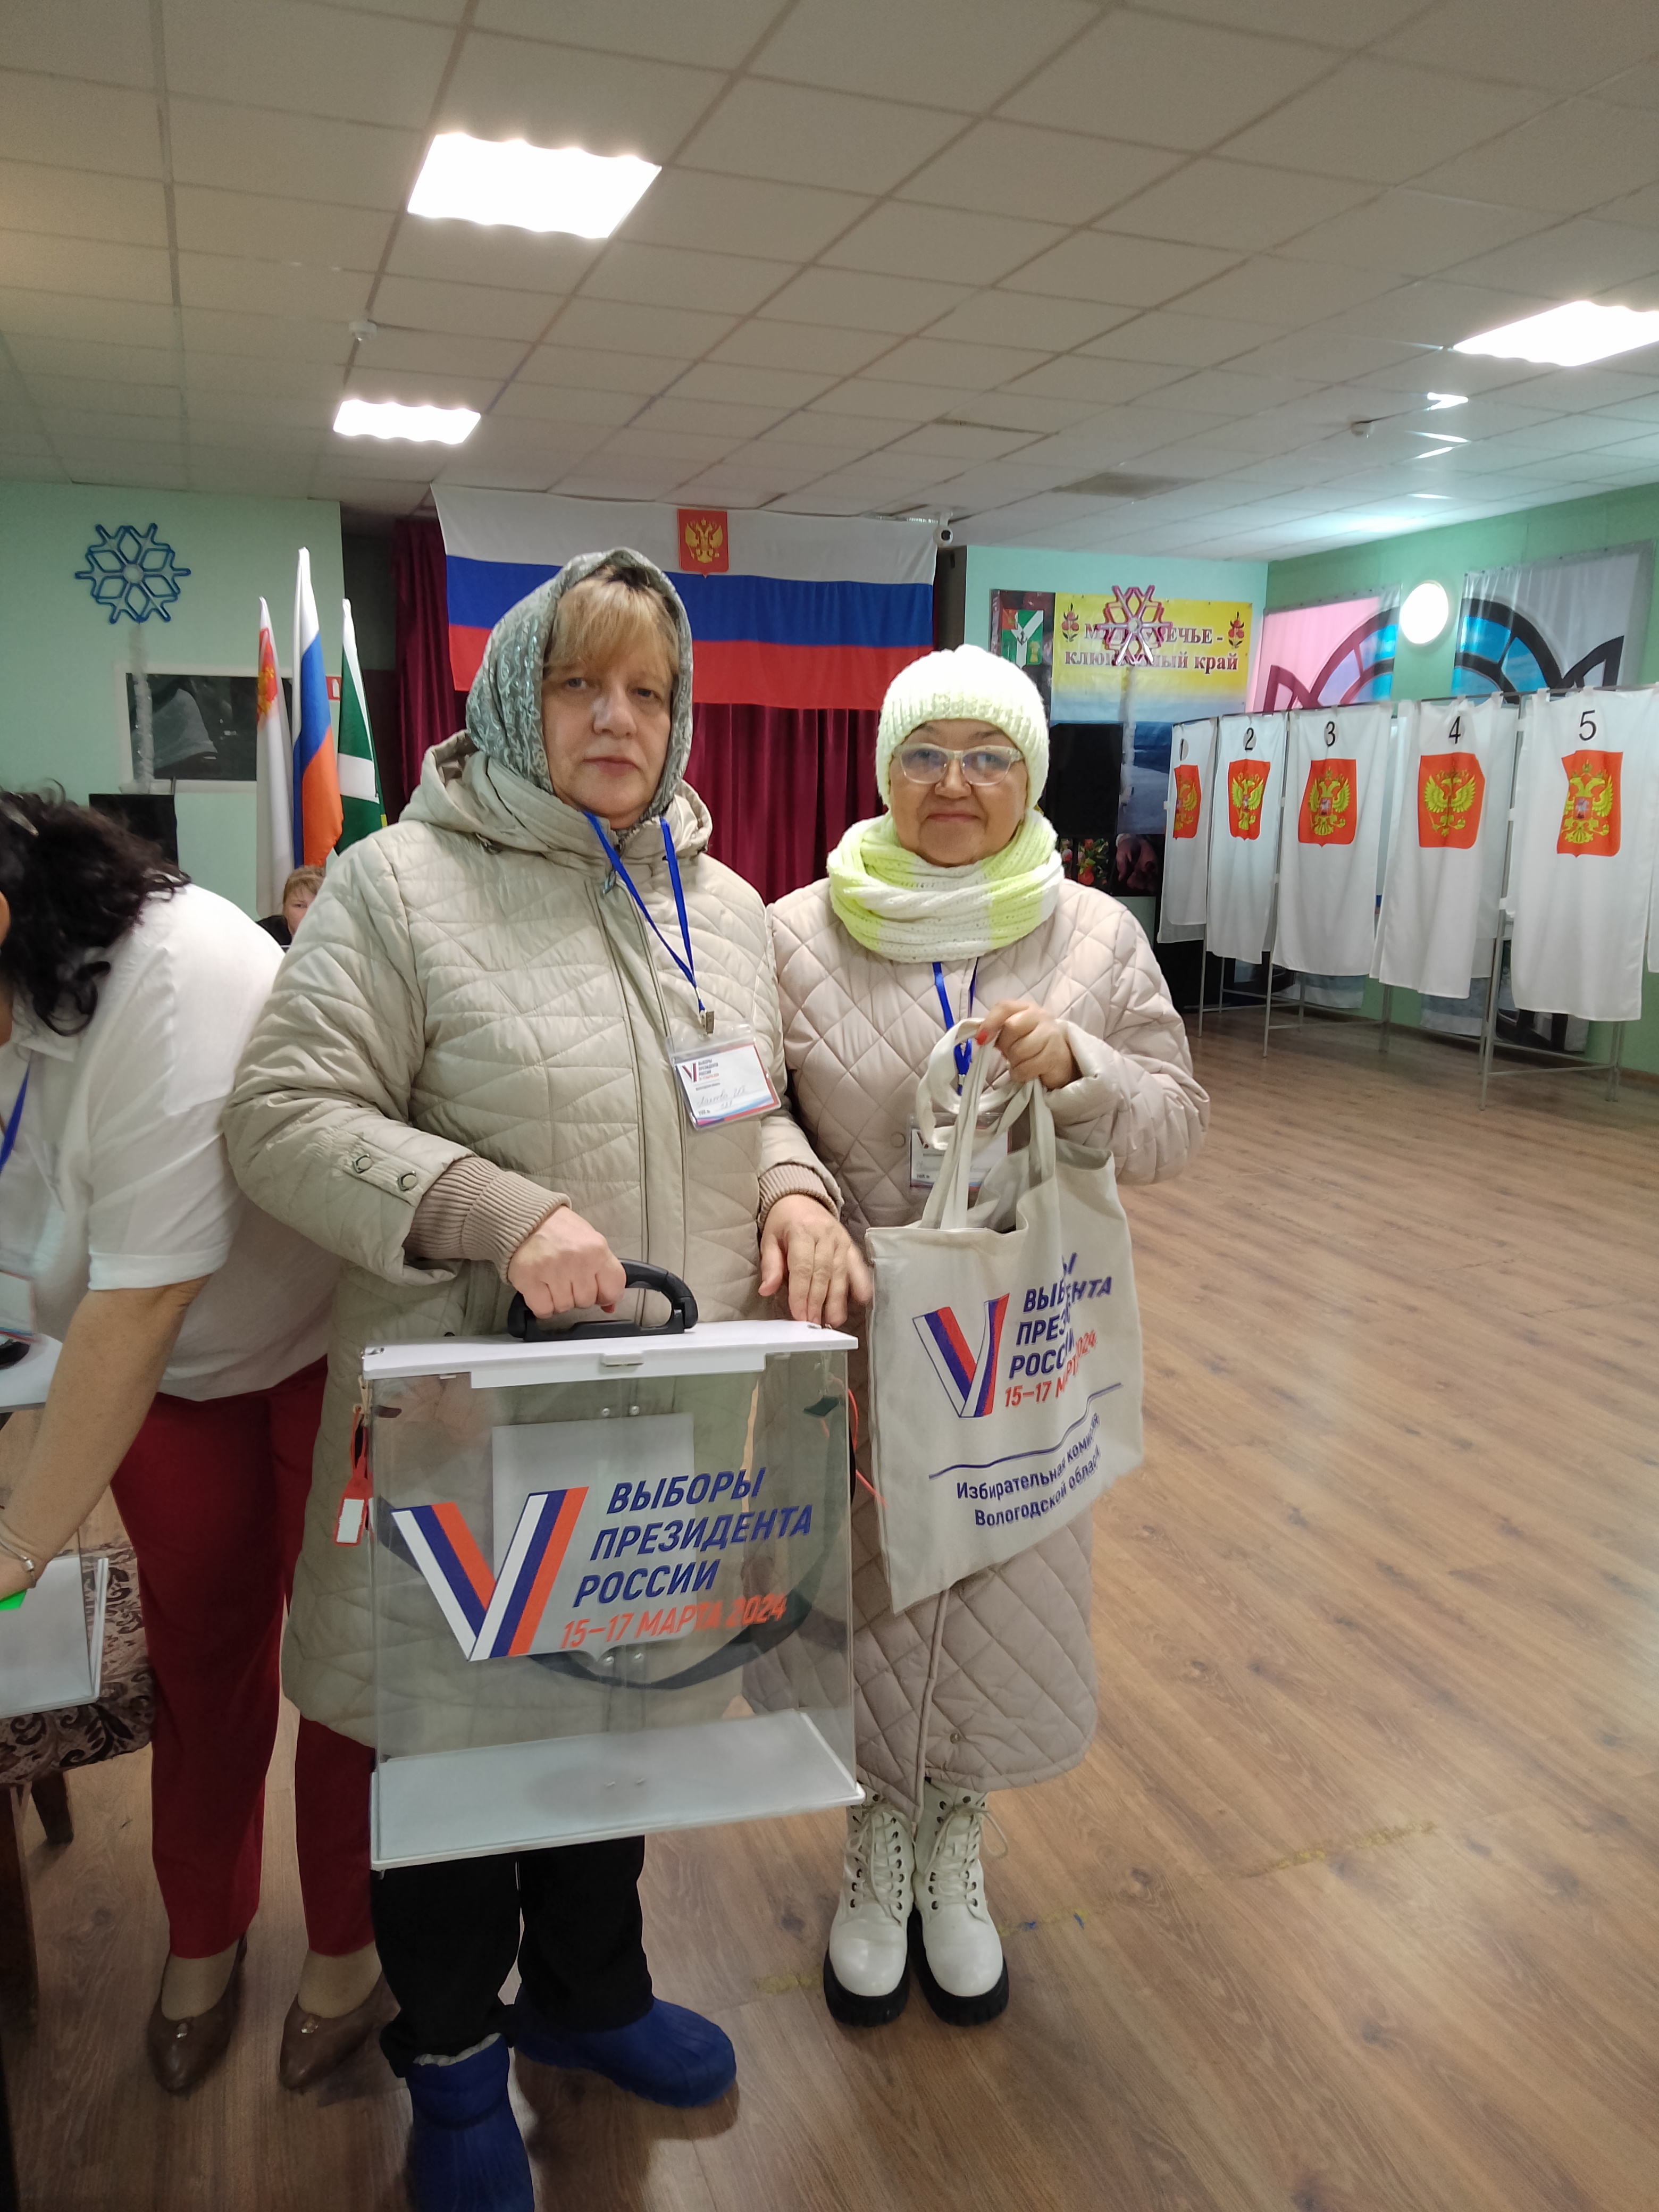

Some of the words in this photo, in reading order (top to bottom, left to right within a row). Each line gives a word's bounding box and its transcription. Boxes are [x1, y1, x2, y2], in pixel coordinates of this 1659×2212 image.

[1065, 651, 1188, 668] клюкный
[1194, 653, 1238, 674] край
[1244, 727, 1254, 751] 2
[1324, 721, 1335, 747] 3
[1448, 716, 1462, 744] 4
[1579, 710, 1597, 741] 5
[1076, 1329, 1097, 1358] 024
[606, 1467, 766, 1514] ВЫБОРЫ
[975, 1480, 1067, 1527] Вологодской
[590, 1504, 812, 1561] ПРЕЗИДЕНТА
[572, 1559, 722, 1608] РОССИИ
[634, 1600, 723, 1639] МАРТА
[725, 1593, 787, 1628] 2024
